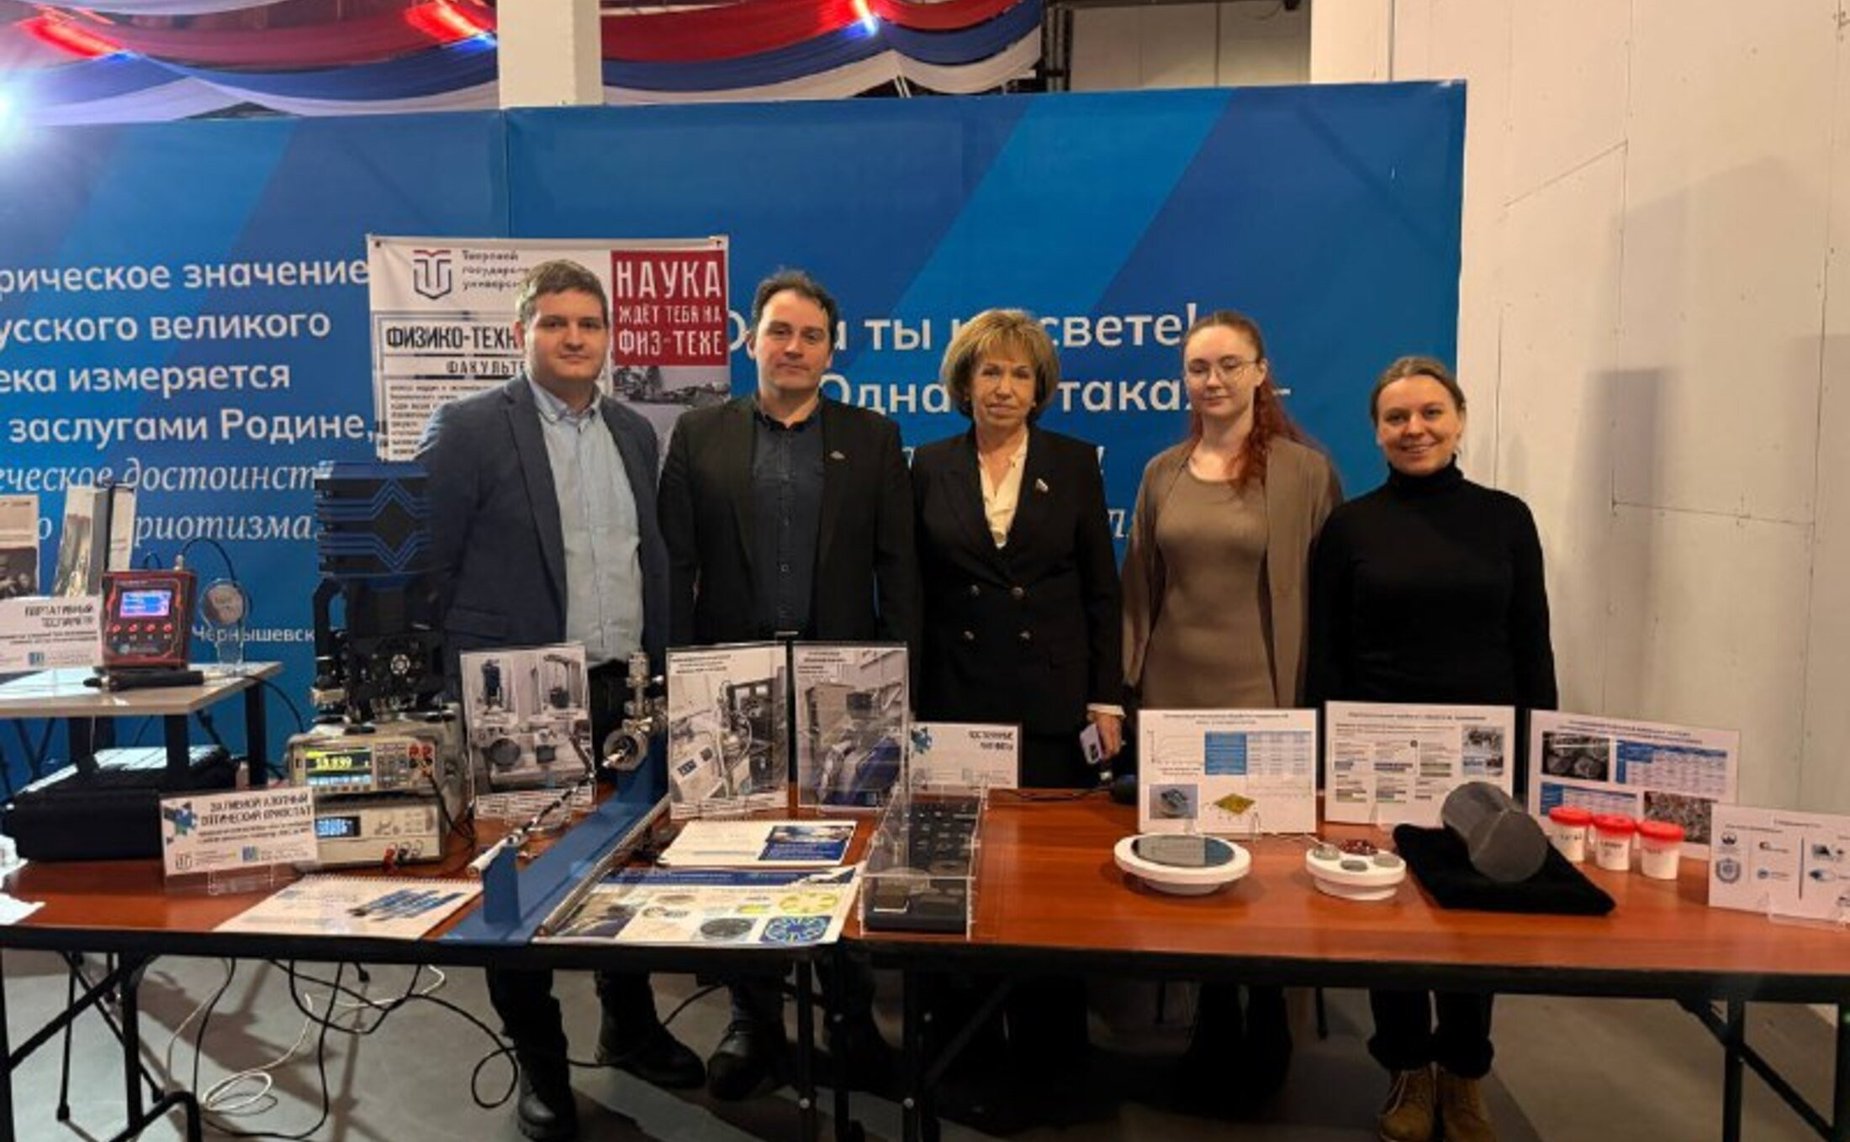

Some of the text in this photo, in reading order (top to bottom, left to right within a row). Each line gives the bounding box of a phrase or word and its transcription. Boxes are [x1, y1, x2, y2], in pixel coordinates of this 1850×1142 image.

[183, 259, 371, 287] значение
[616, 260, 723, 299] НАУКА
[151, 312, 331, 341] великого
[618, 303, 723, 326] ЖДЁТ ТЕБЯ НА
[618, 328, 723, 356] ФИЗ-ТЕХЕ
[864, 319, 931, 350] ты
[69, 363, 290, 399] измеряется
[1057, 374, 1194, 412] така
[9, 416, 209, 450] заслугами
[220, 408, 375, 444] Родине,
